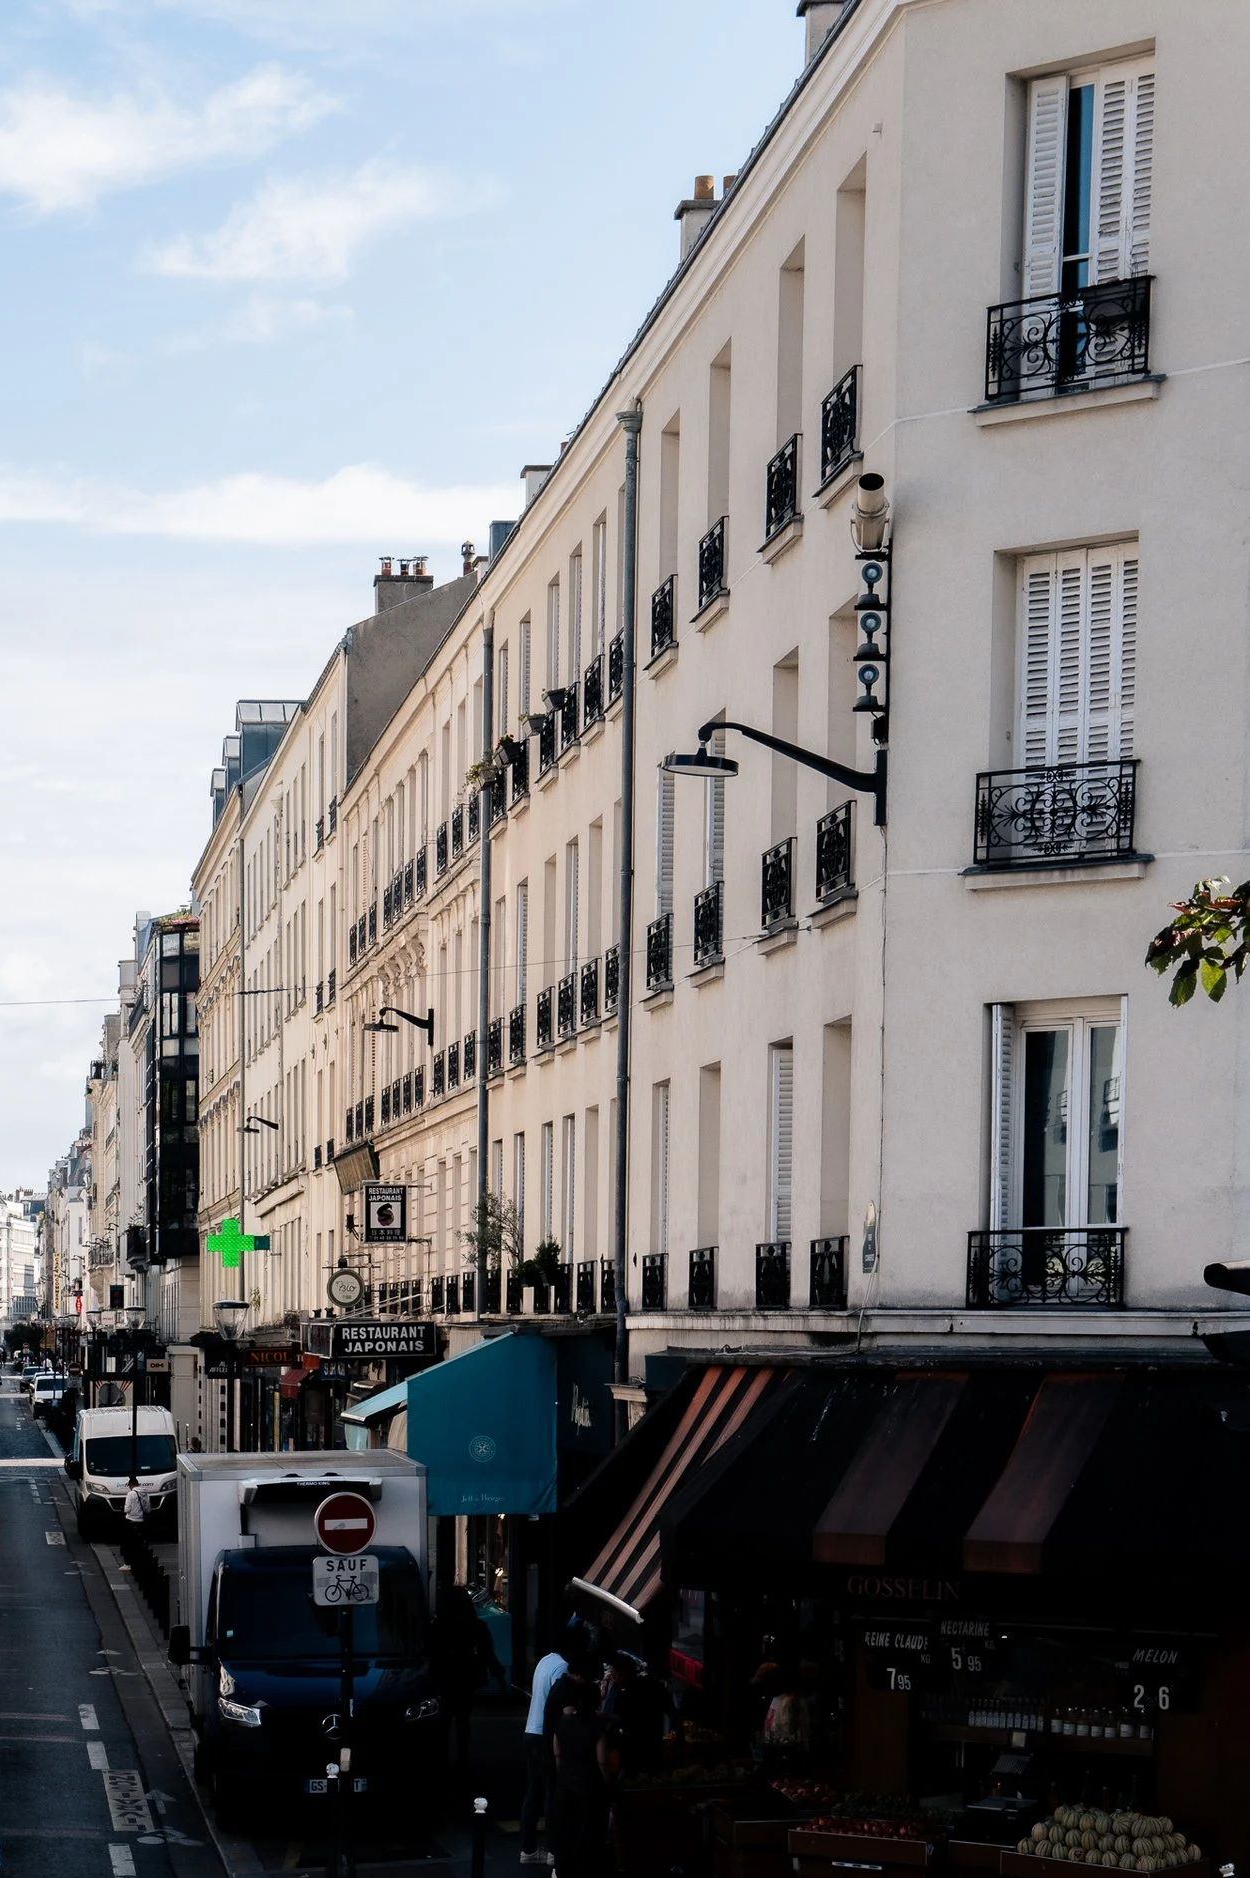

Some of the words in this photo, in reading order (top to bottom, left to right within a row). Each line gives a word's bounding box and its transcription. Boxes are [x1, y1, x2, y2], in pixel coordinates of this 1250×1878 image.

[368, 1187, 404, 1195] RESTAURANT
[368, 1194, 402, 1202] JAPONAIS
[342, 1325, 426, 1340] RESTAURANT
[344, 1341, 425, 1353] JAPONAIS
[326, 1559, 368, 1572] SAUF
[847, 1574, 962, 1601] GOSSELIN
[939, 1619, 991, 1637] NECTARINE
[863, 1631, 891, 1648] REINE
[894, 1632, 929, 1651] CLAUDE
[920, 1653, 931, 1664] KG
[1132, 1648, 1179, 1665] MELON
